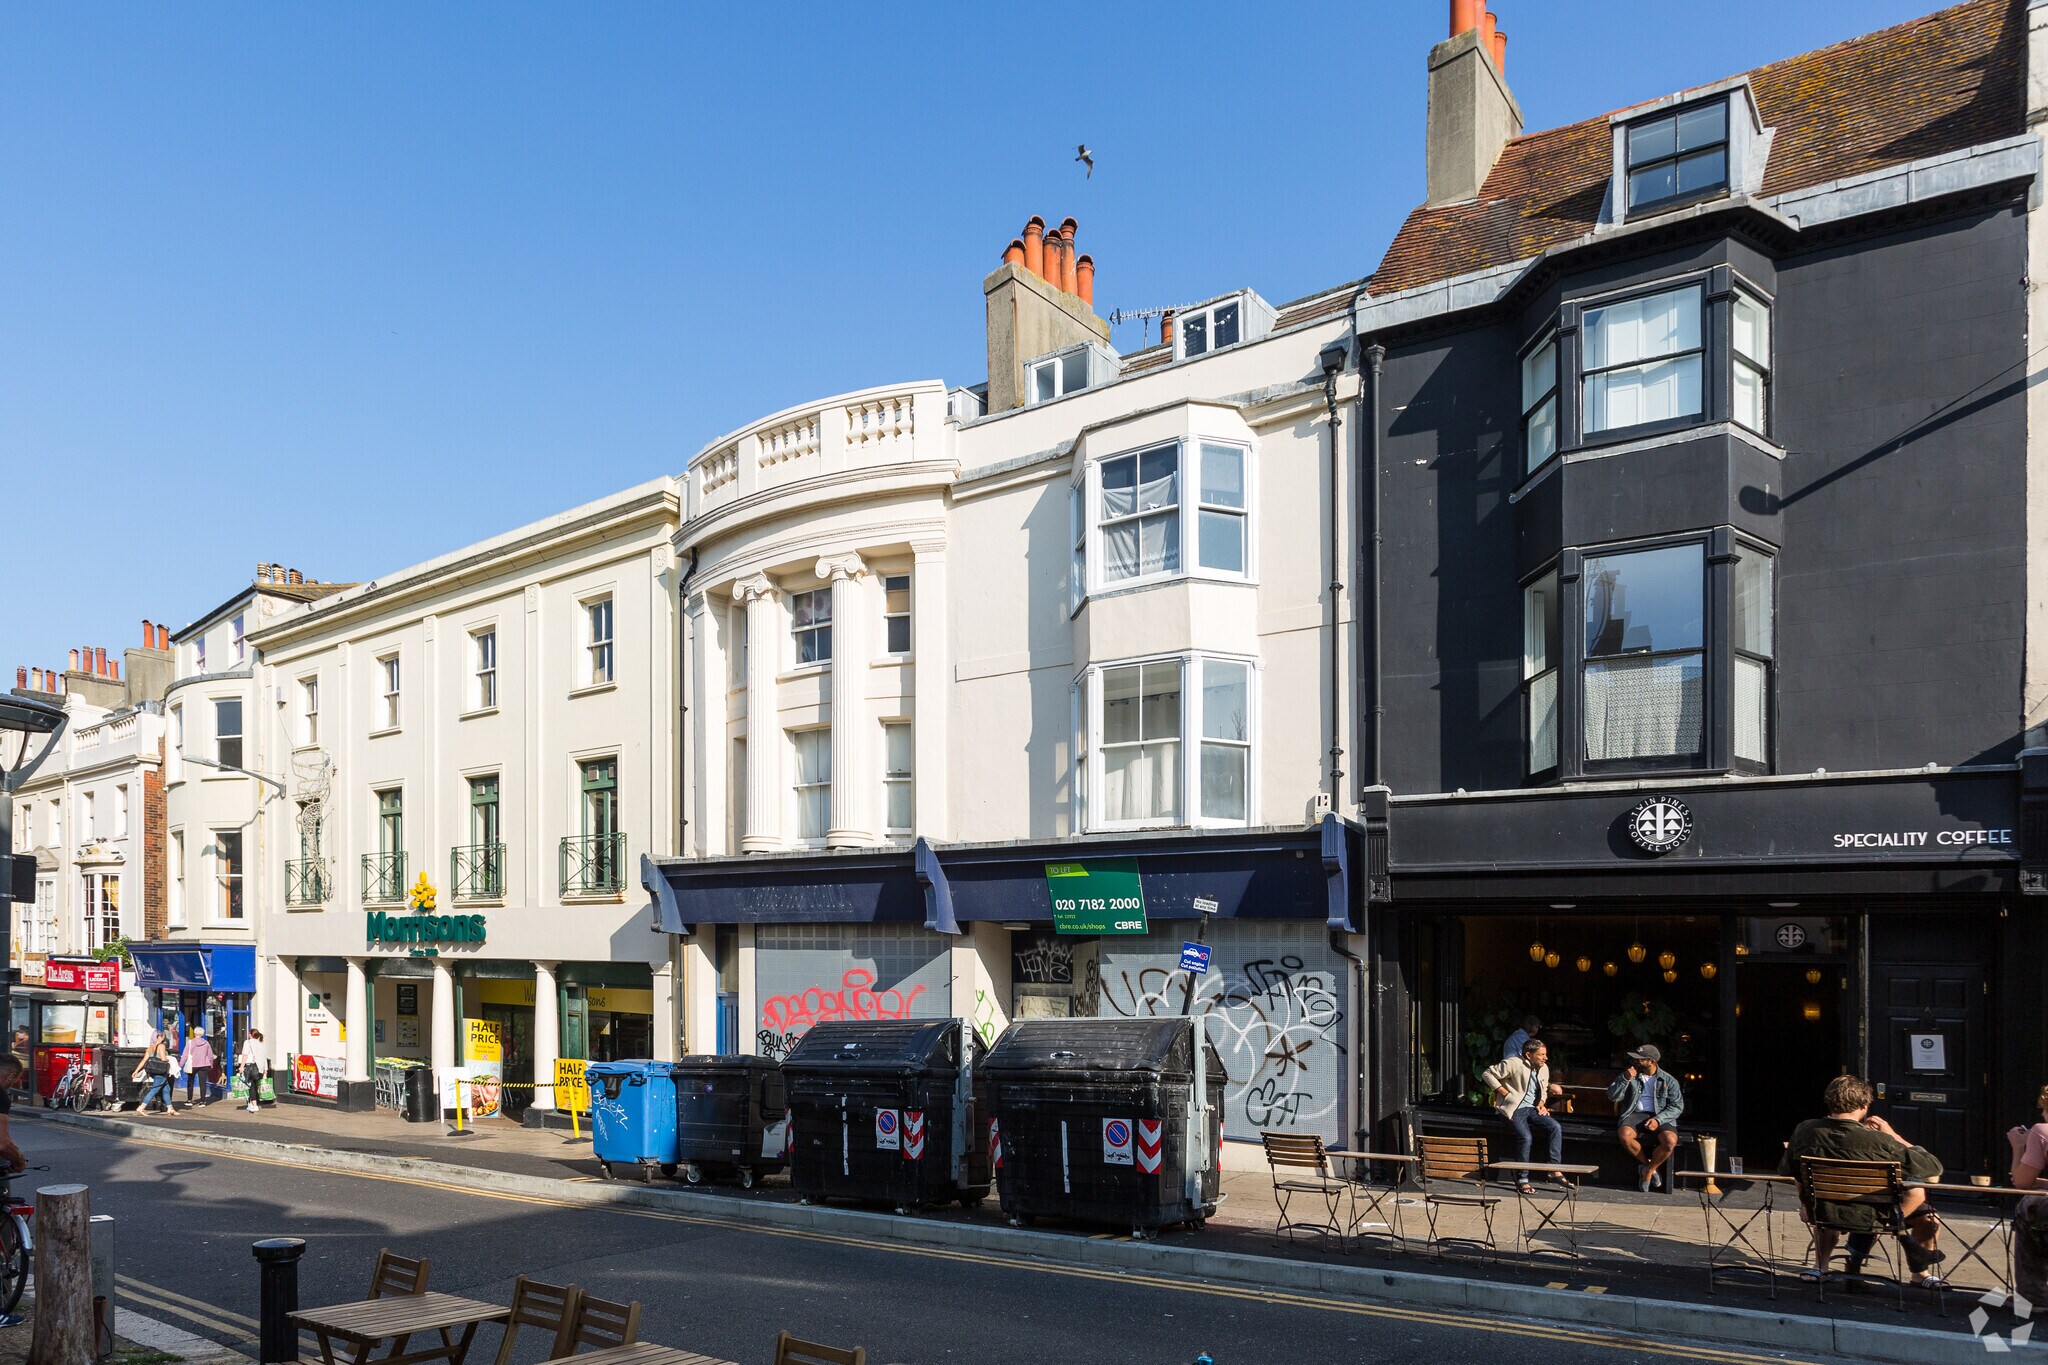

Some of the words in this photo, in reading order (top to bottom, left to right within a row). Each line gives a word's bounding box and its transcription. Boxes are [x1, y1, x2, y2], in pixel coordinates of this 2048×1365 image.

[1631, 797, 1656, 816] TWIN
[1661, 796, 1690, 816] PINES
[1629, 824, 1660, 852] COFFEE
[1665, 822, 1692, 850] HOUSE
[1833, 831, 1928, 848] SPECIALITY
[1936, 829, 2012, 845] COFFEE
[1060, 866, 1071, 874] LET
[1055, 899, 1076, 910] 020
[1078, 898, 1106, 910] 7182
[1109, 897, 1140, 910] 2000
[366, 911, 487, 942] Morrisons
[1114, 921, 1142, 929] CBRE
[47, 966, 58, 980] The
[58, 966, 74, 981] Argus
[471, 1021, 500, 1034] HALF
[470, 1033, 499, 1044] PRICE
[559, 1062, 583, 1075] HALF
[299, 1070, 316, 1082] PRICE
[299, 1079, 316, 1092] CUTS
